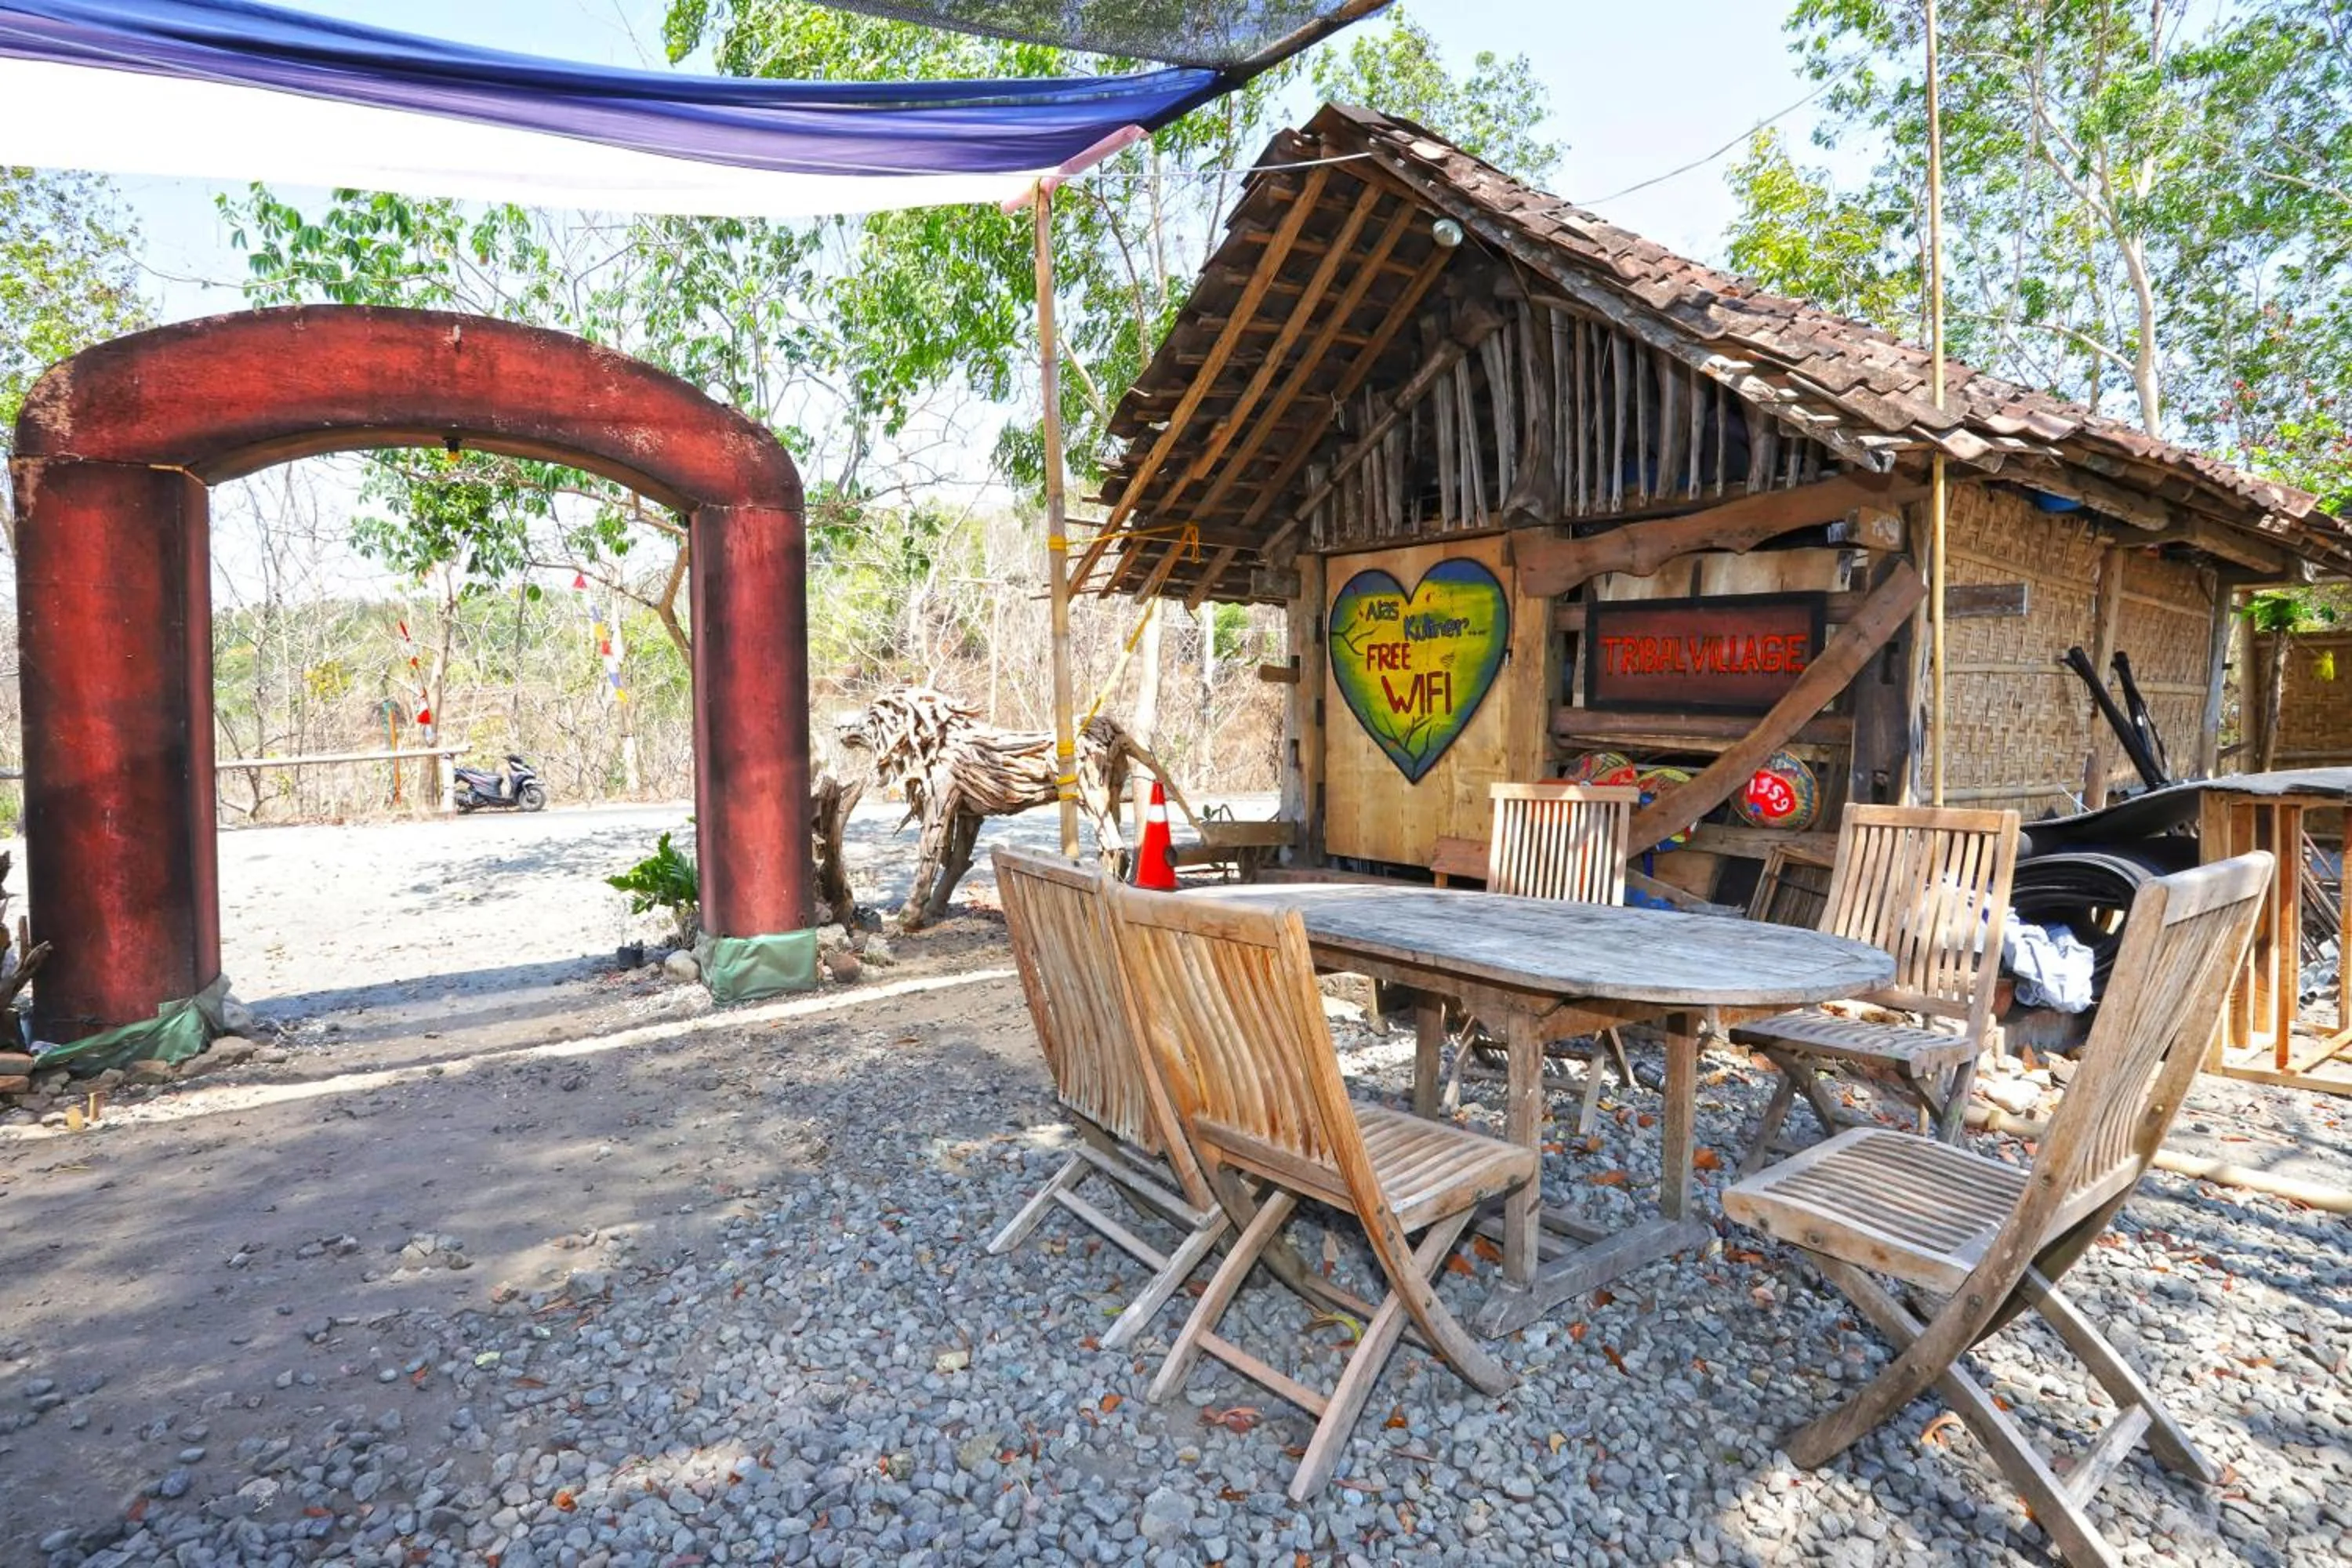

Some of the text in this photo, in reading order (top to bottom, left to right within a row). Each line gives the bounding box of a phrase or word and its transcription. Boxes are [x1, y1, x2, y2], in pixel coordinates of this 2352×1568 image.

[1367, 643, 1411, 671] FREE
[1688, 633, 1807, 674] VILLAGE
[1381, 671, 1451, 715] WIFI
